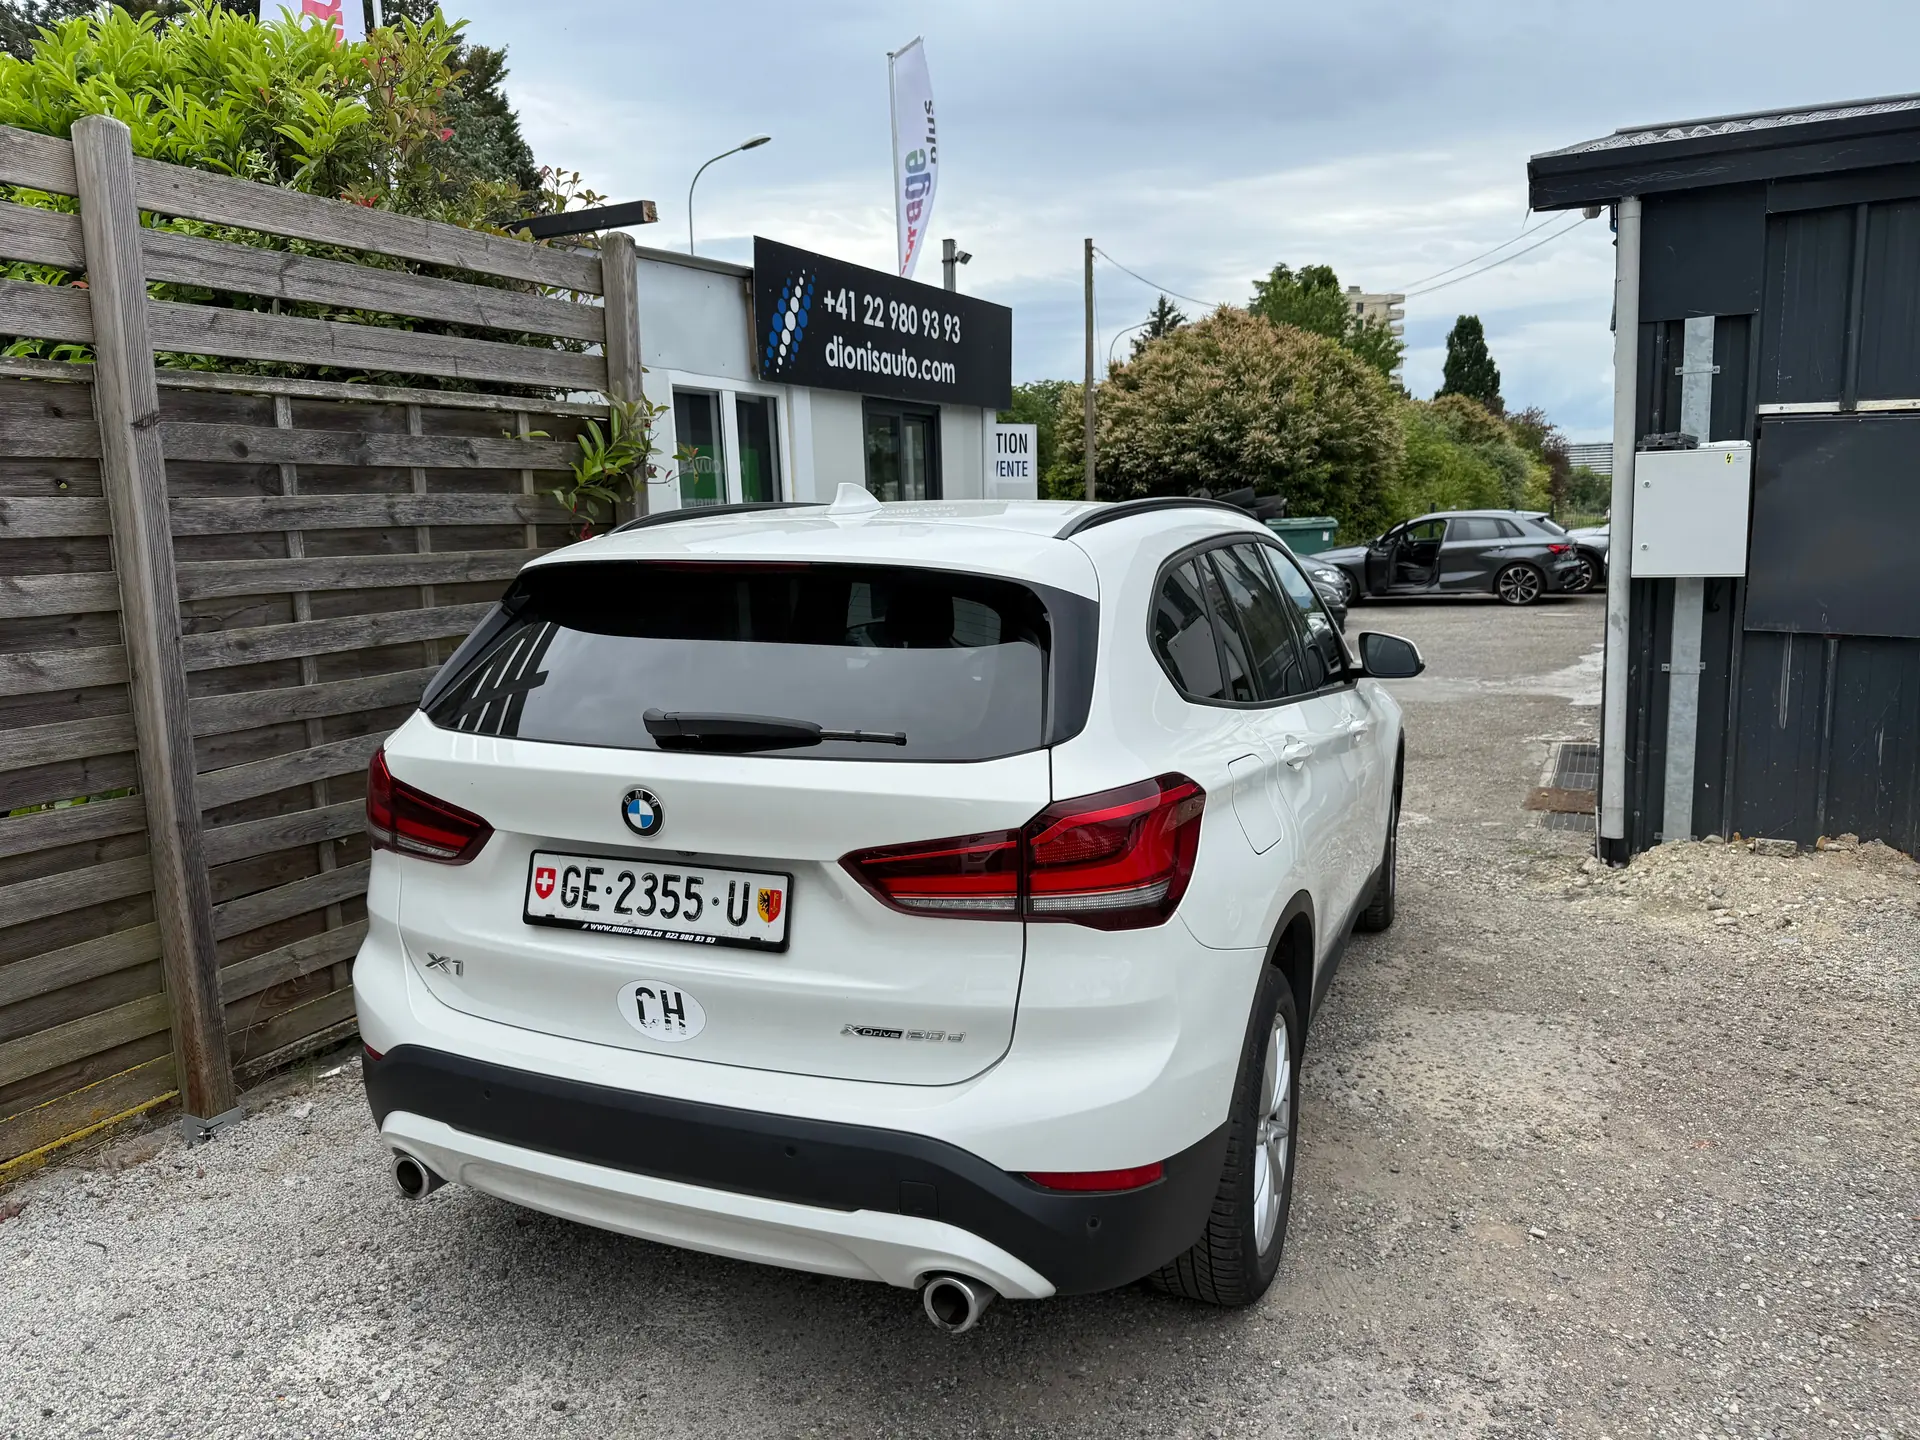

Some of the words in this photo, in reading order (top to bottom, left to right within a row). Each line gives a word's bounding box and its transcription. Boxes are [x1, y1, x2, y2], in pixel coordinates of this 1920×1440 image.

[901, 148, 932, 275] rage
[823, 288, 856, 322] +41
[863, 294, 885, 328] 22
[889, 300, 918, 335] 980
[922, 308, 940, 339] 93
[944, 313, 961, 344] 93
[825, 335, 956, 384] dionisauto.com
[995, 432, 1028, 454] TION
[624, 790, 659, 808] BMW
[665, 931, 679, 940] 022
[679, 933, 694, 941] 980
[694, 935, 705, 943] 93
[705, 936, 716, 944] 93
[425, 951, 464, 978] X1
[635, 986, 687, 1035] CH
